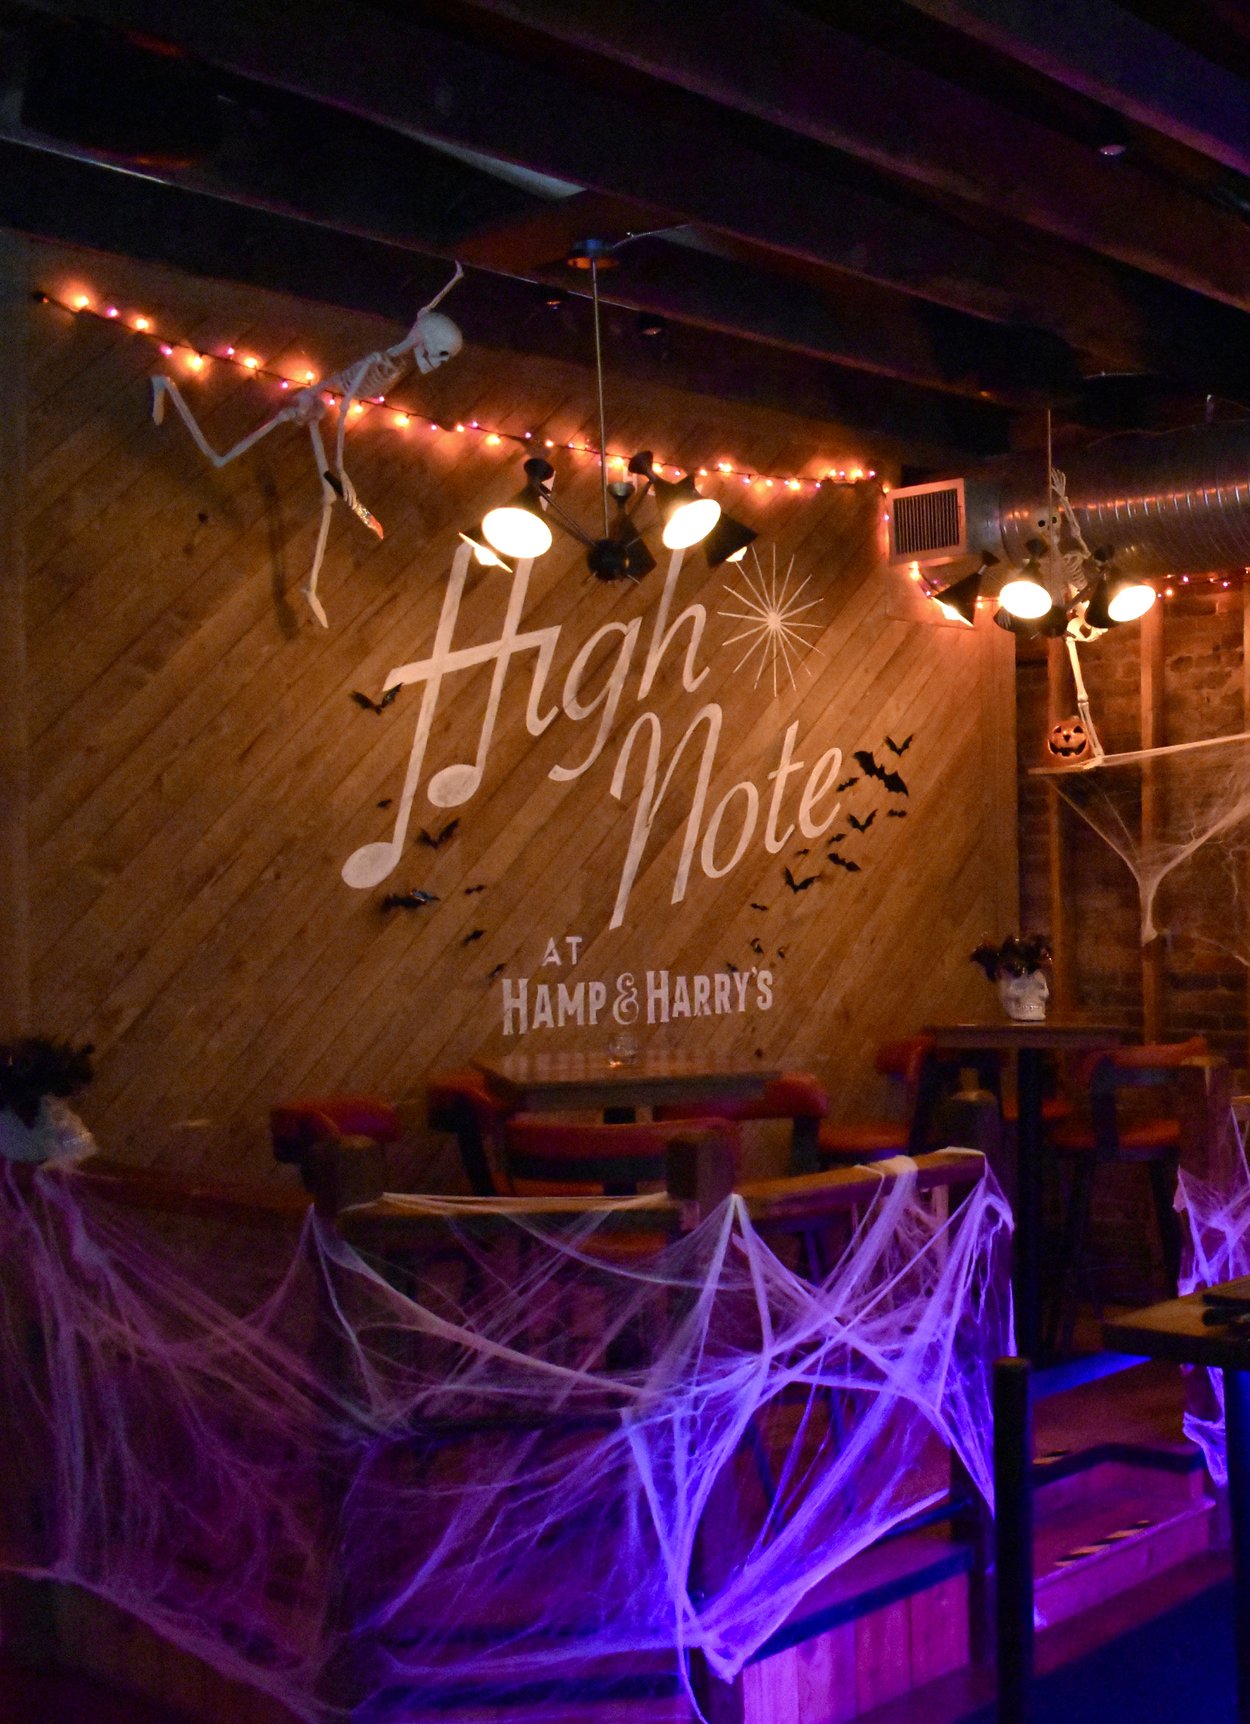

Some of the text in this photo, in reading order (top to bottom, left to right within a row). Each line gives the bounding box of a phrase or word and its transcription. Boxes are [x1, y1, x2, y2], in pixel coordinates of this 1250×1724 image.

[341, 468, 710, 889] High
[608, 702, 843, 930] Note
[502, 966, 774, 1036] HAMP & HARRY'S
[541, 935, 583, 967] AT
